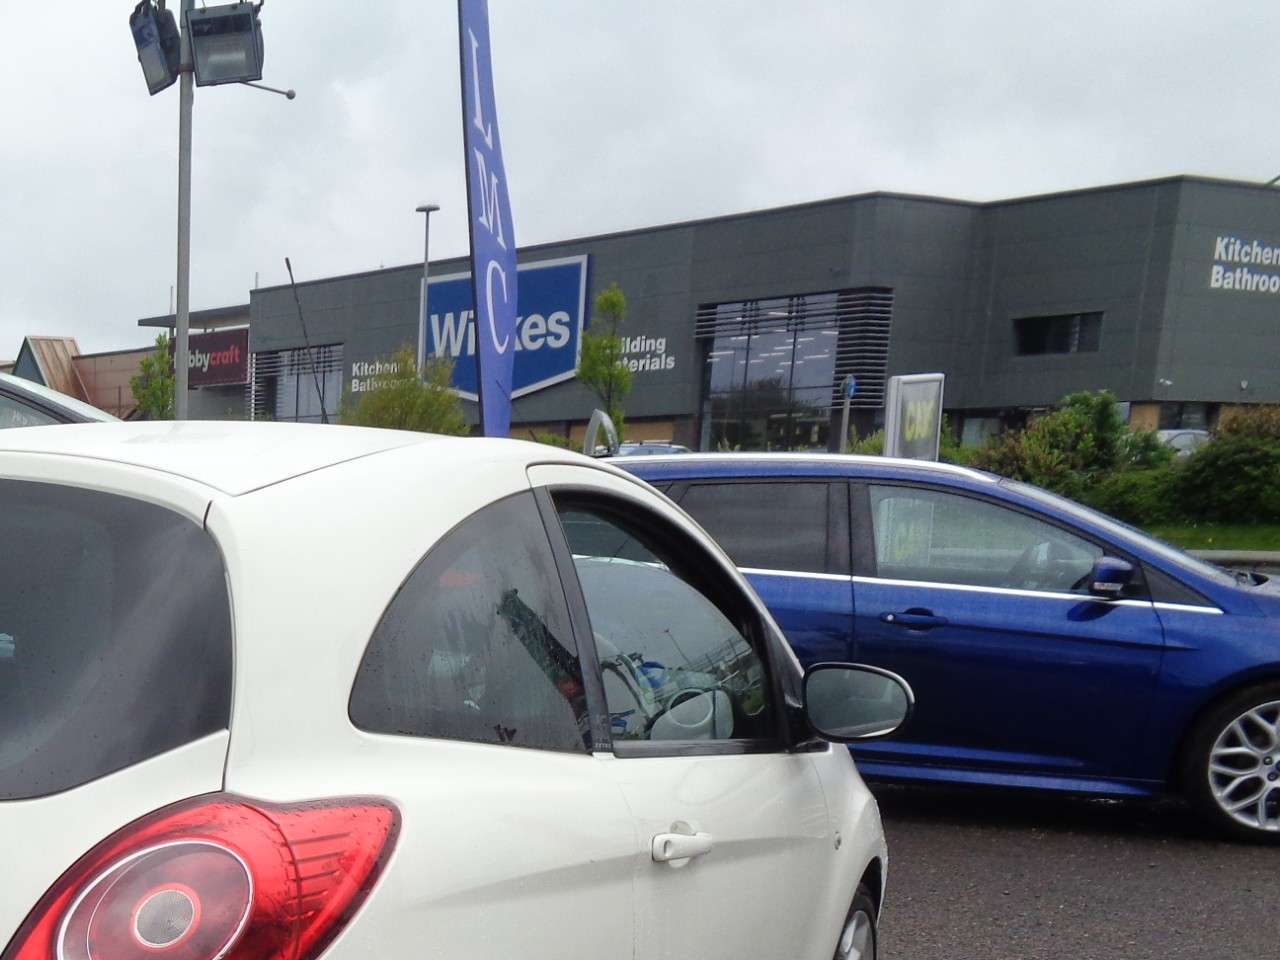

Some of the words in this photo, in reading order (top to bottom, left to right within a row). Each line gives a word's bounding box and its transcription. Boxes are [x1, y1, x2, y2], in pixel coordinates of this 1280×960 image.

[468, 27, 510, 355] LMC
[430, 310, 570, 358] Wies
[620, 335, 667, 354] ilding
[174, 344, 241, 373] bbycraft
[351, 361, 401, 377] Kitchen
[616, 353, 676, 373] terials
